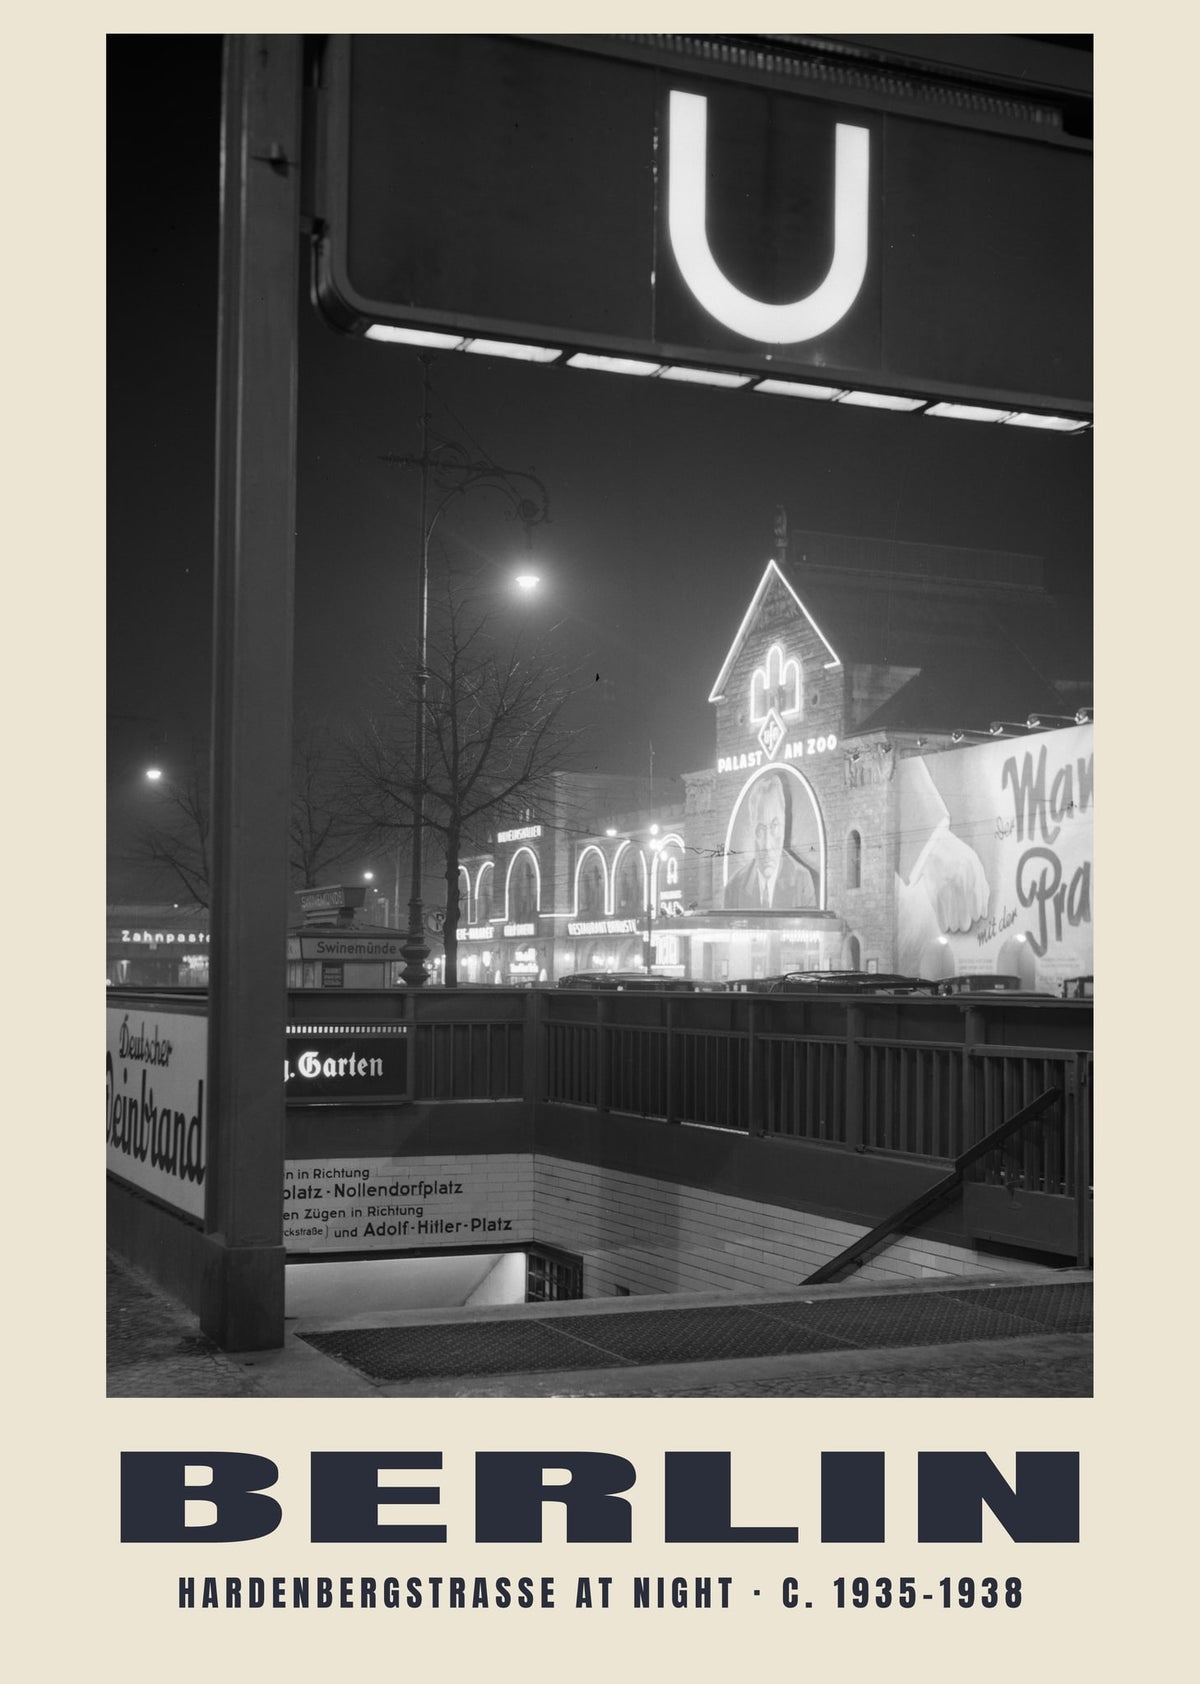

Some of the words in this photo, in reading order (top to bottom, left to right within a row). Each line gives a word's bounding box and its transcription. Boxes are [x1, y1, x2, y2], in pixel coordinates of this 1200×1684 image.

[667, 89, 870, 345] U
[717, 750, 763, 773] PALAST
[784, 741, 803, 759] AM
[807, 734, 837, 755] ZOO
[977, 917, 997, 947] mit
[999, 905, 1018, 932] der
[316, 941, 397, 954] Swinemünde
[119, 1014, 173, 1067] Deutscher
[298, 1051, 383, 1078] Garten
[298, 1169, 309, 1180] in
[313, 1168, 370, 1181] Richtung
[304, 1208, 346, 1222] Zügen
[351, 1207, 362, 1218] in
[367, 1205, 424, 1218] Richtung
[334, 1227, 358, 1238] und
